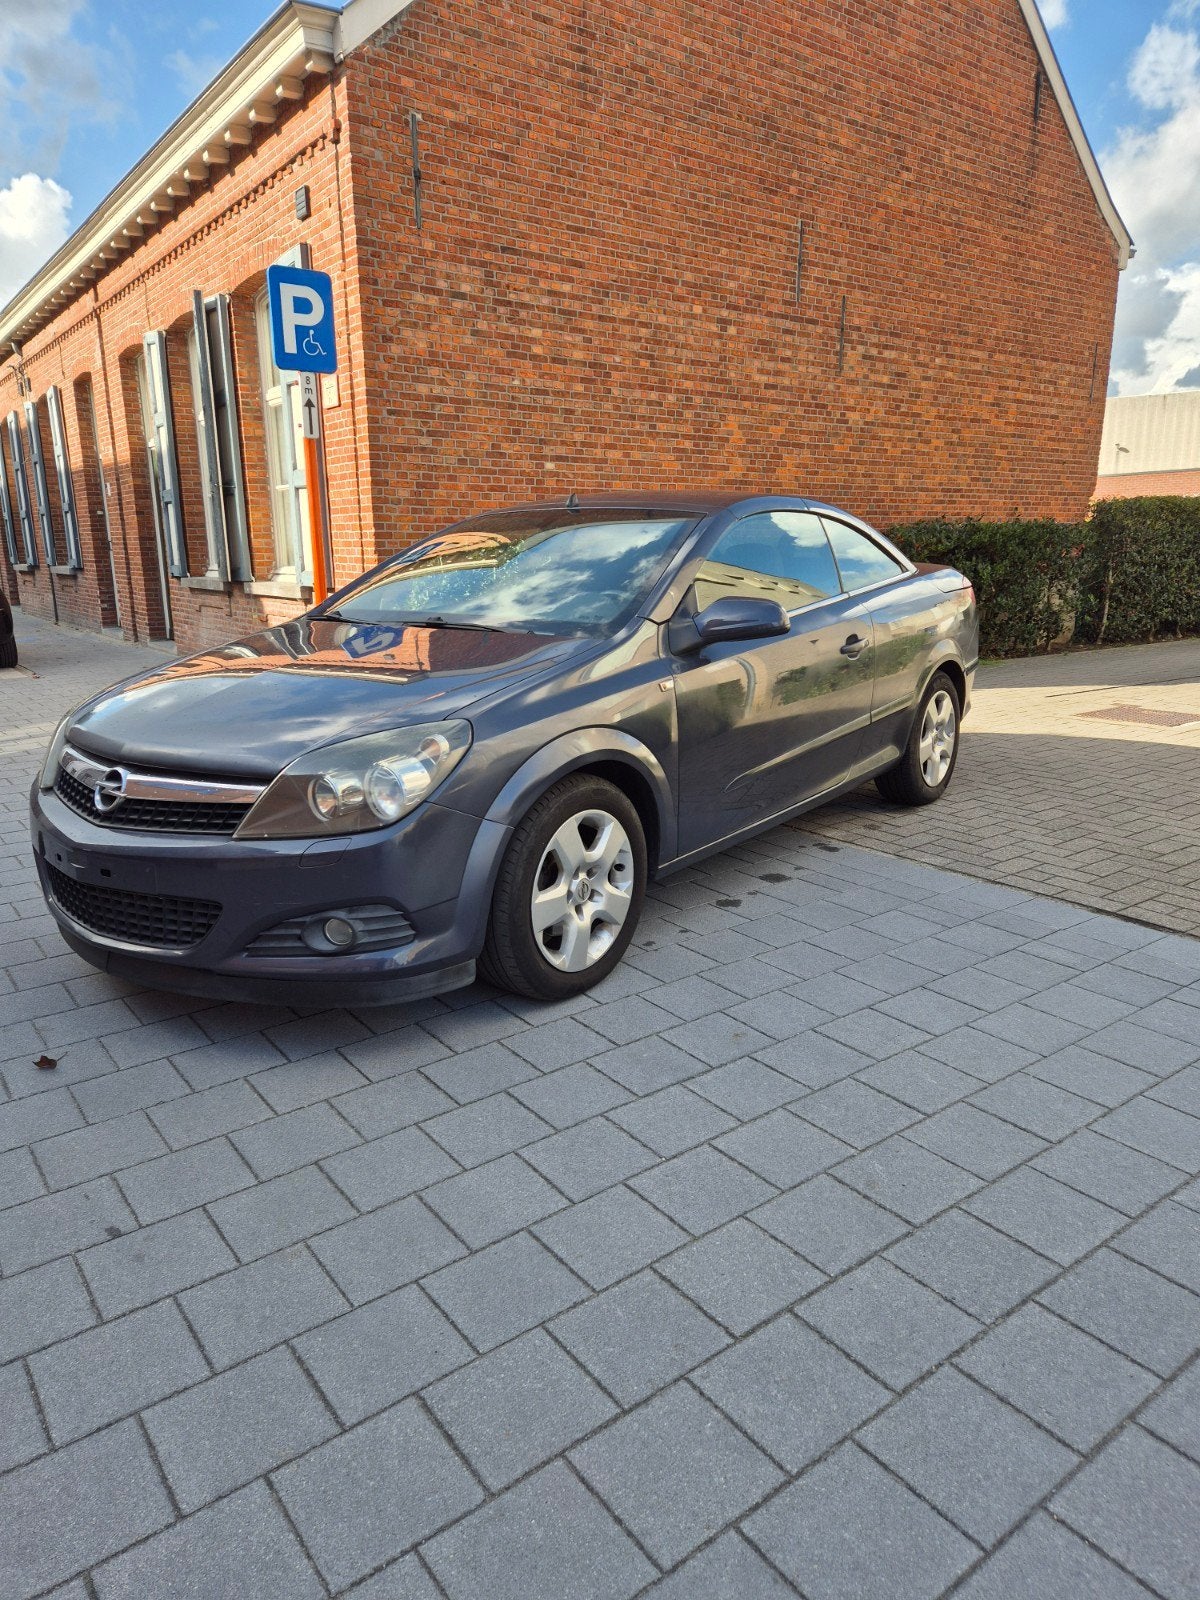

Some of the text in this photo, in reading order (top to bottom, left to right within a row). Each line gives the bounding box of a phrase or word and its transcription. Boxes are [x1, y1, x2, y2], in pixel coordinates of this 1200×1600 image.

[279, 282, 325, 355] P
[305, 375, 311, 385] 8
[304, 387, 313, 395] m
